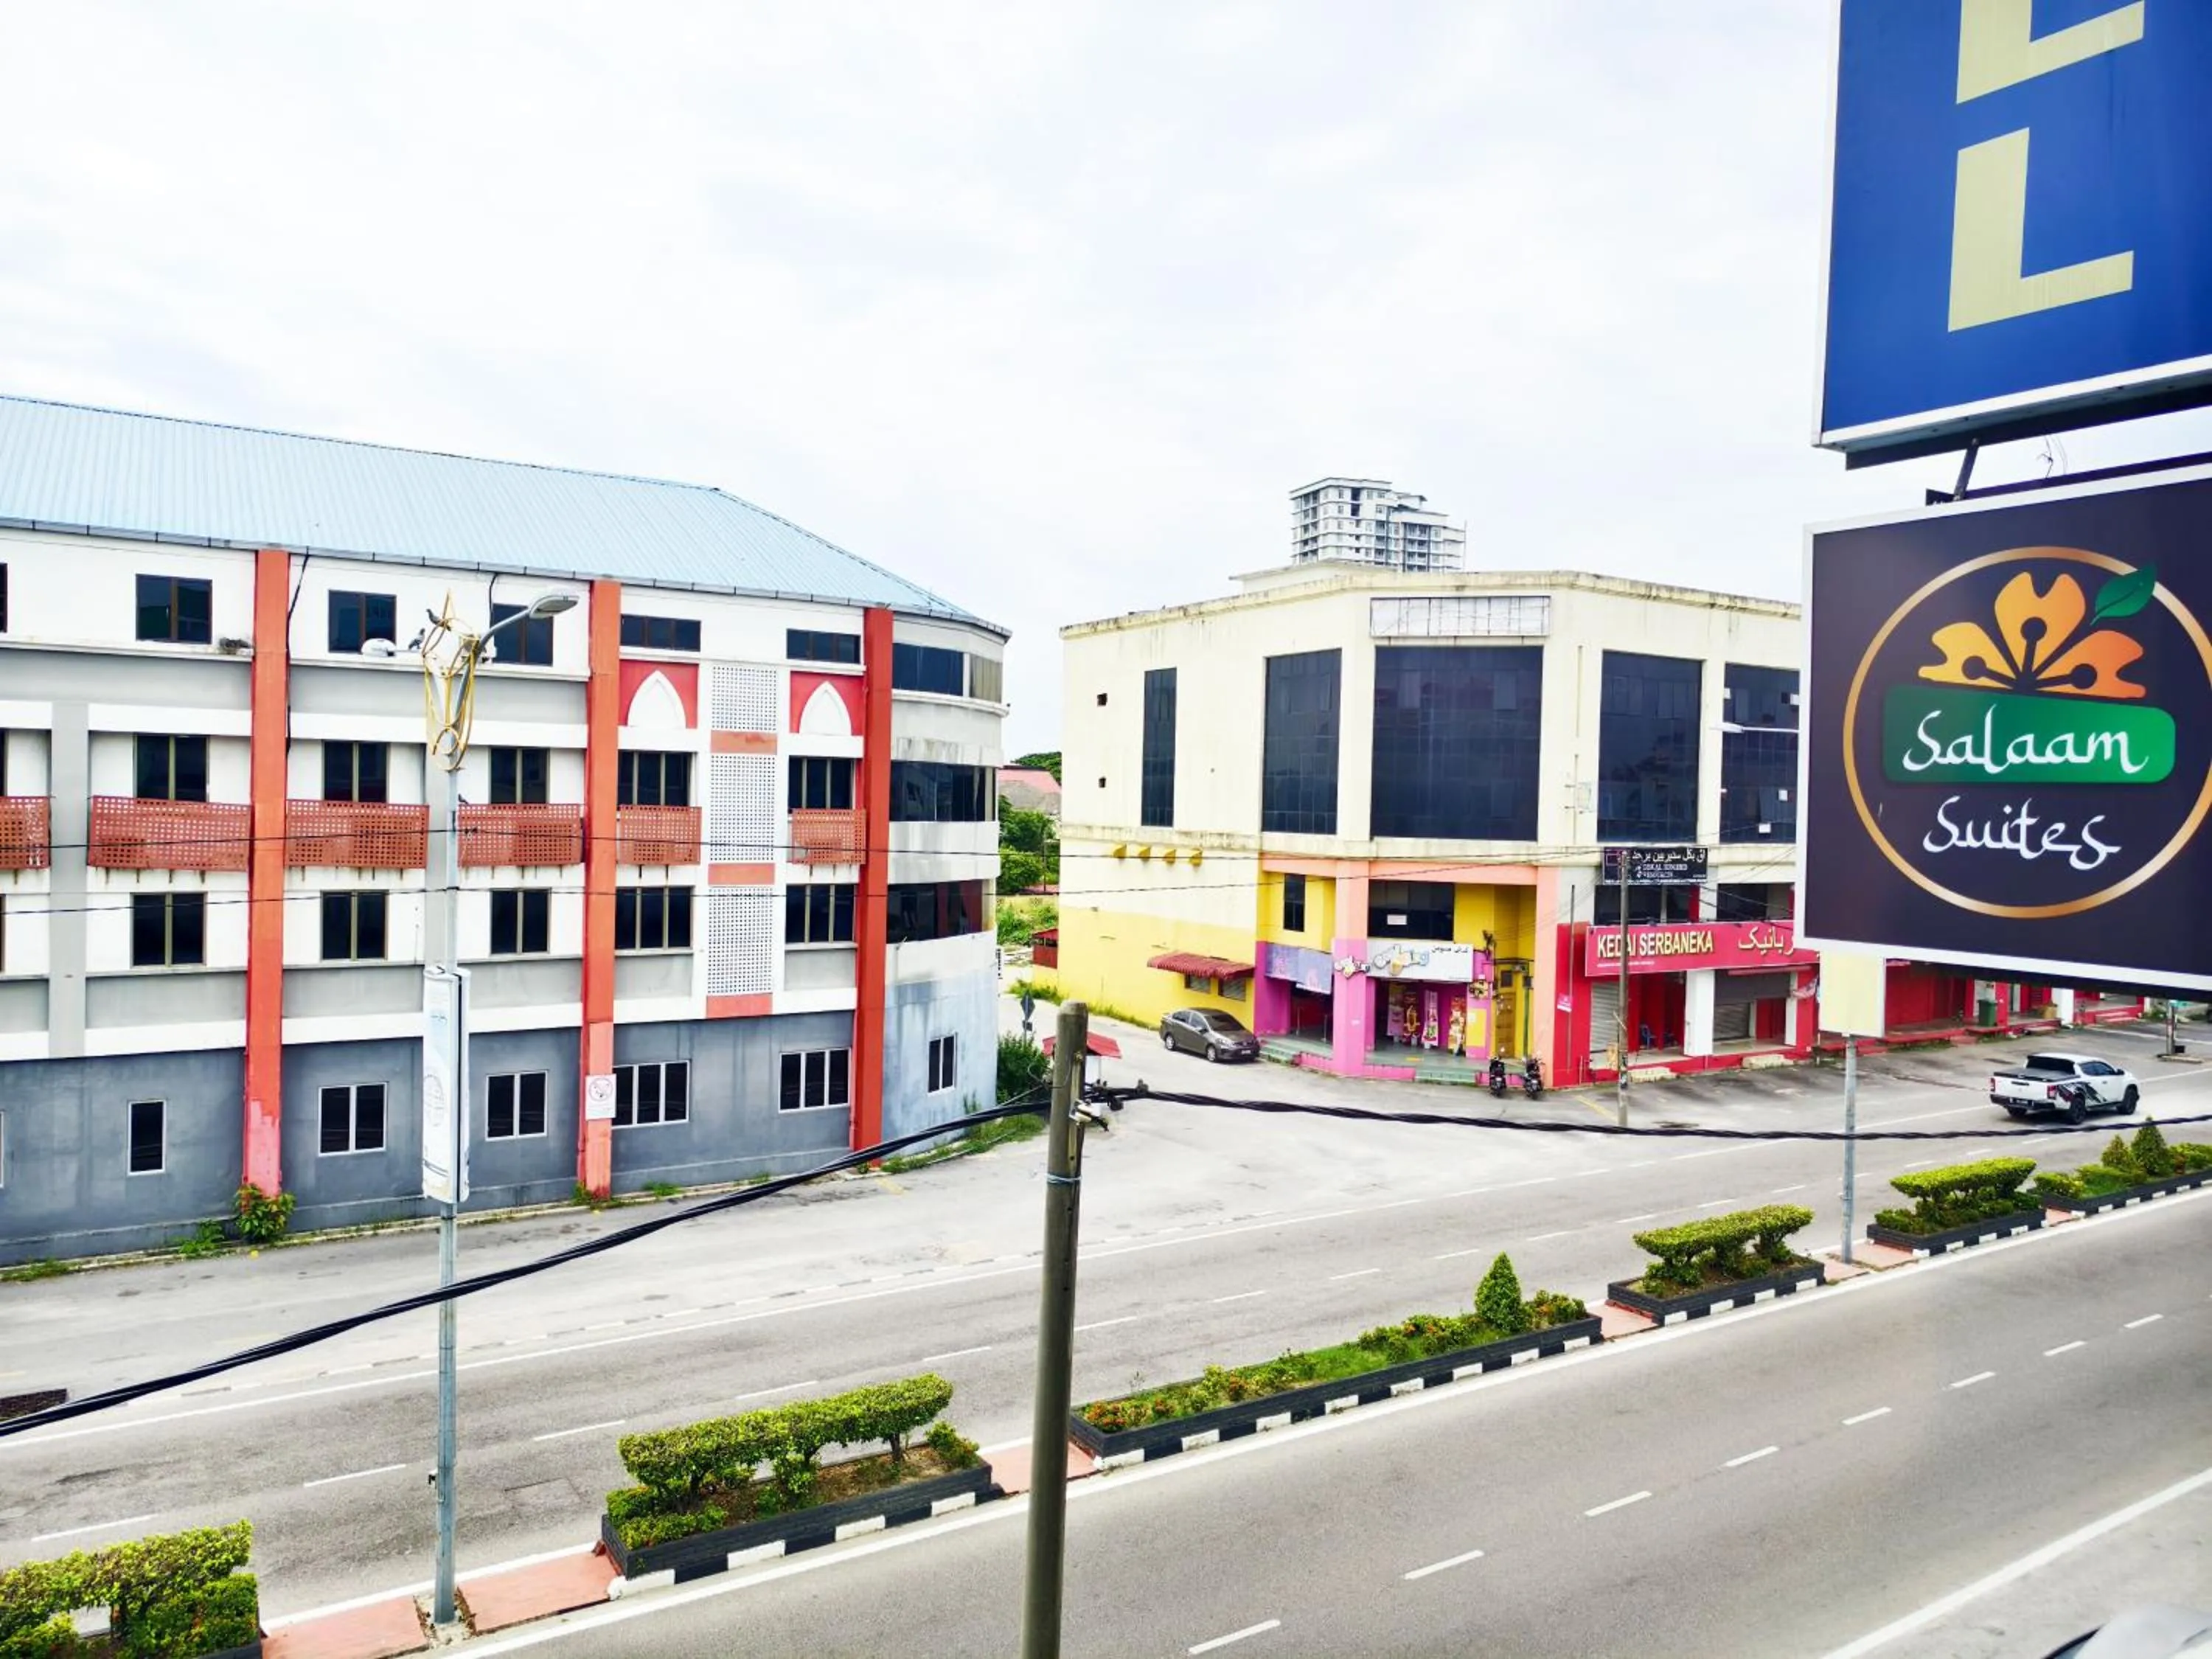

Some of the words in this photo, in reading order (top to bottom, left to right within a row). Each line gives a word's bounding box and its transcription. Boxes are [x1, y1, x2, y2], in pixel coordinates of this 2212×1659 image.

[1902, 703, 2149, 774] Salaam
[1922, 796, 2121, 870] Suites
[1639, 930, 1714, 957] SERBANEKA
